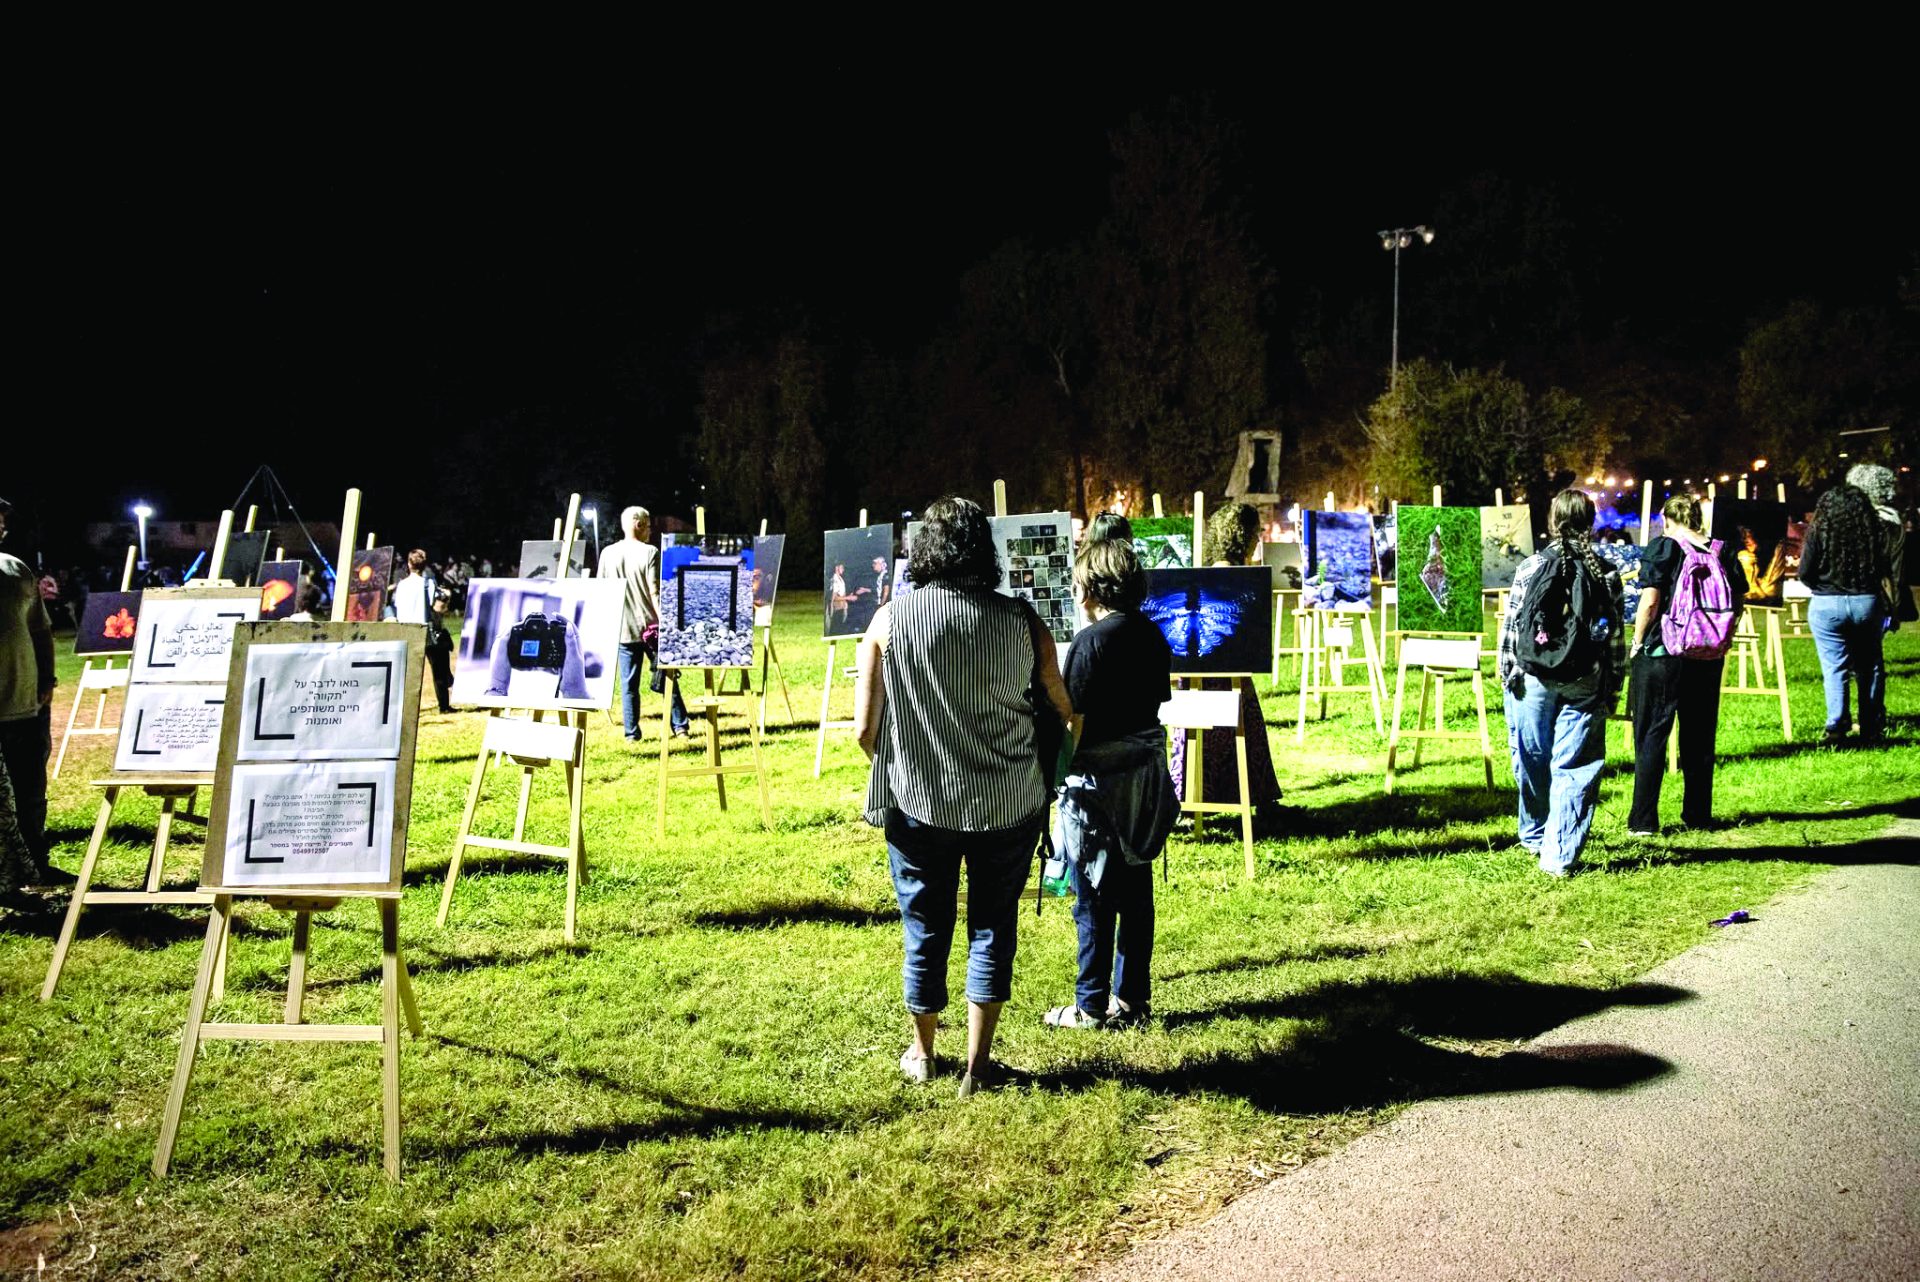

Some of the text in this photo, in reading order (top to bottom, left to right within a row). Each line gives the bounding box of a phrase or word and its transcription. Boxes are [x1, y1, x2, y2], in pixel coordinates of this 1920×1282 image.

[202, 623, 223, 632] تعالوا
[295, 679, 307, 688] על
[311, 678, 336, 688] לדבר
[290, 704, 360, 714] חיים משותפים
[305, 717, 342, 725] ואומנות
